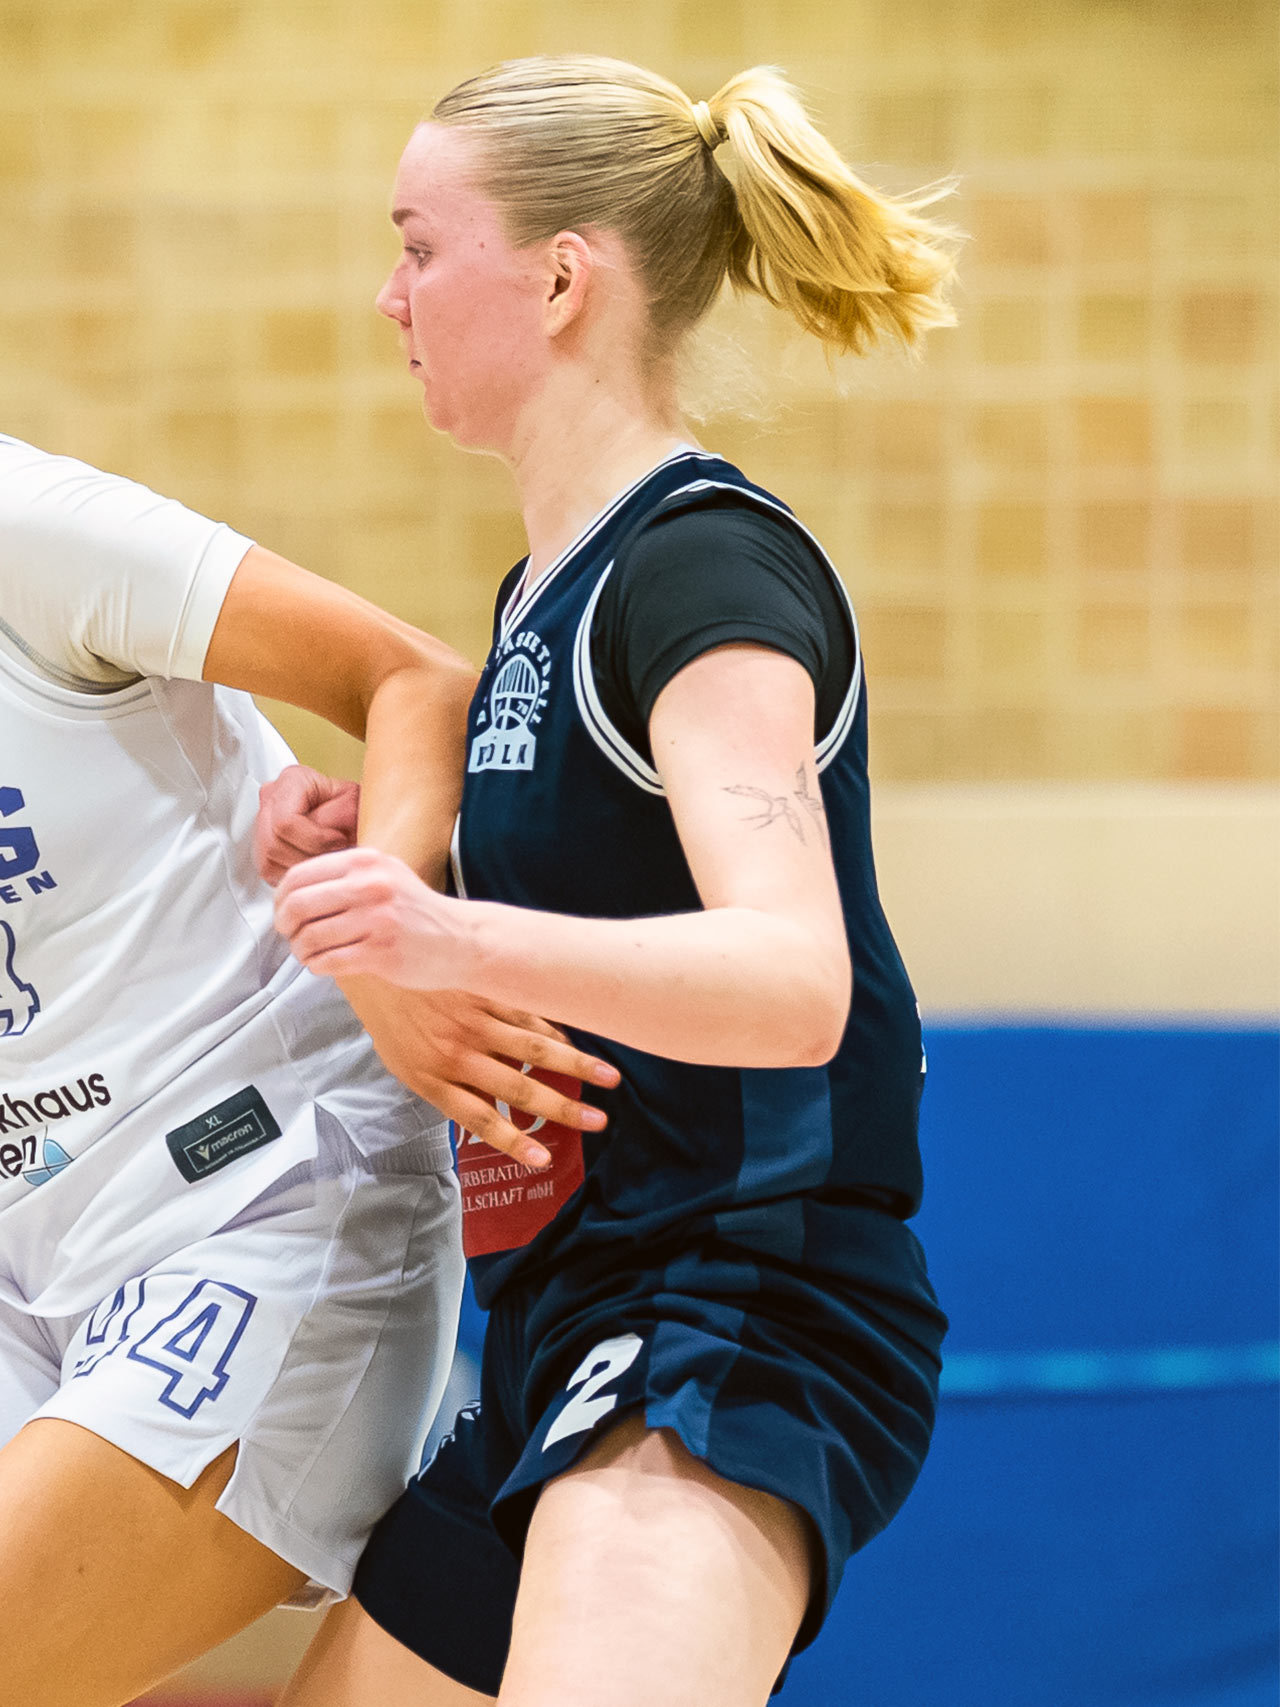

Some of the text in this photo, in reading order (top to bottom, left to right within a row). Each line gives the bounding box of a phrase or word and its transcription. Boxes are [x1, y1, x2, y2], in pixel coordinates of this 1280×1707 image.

[205, 1114, 223, 1129] XL
[210, 1123, 254, 1152] macron
[527, 1180, 554, 1201] mbH
[541, 1332, 644, 1453] 2
